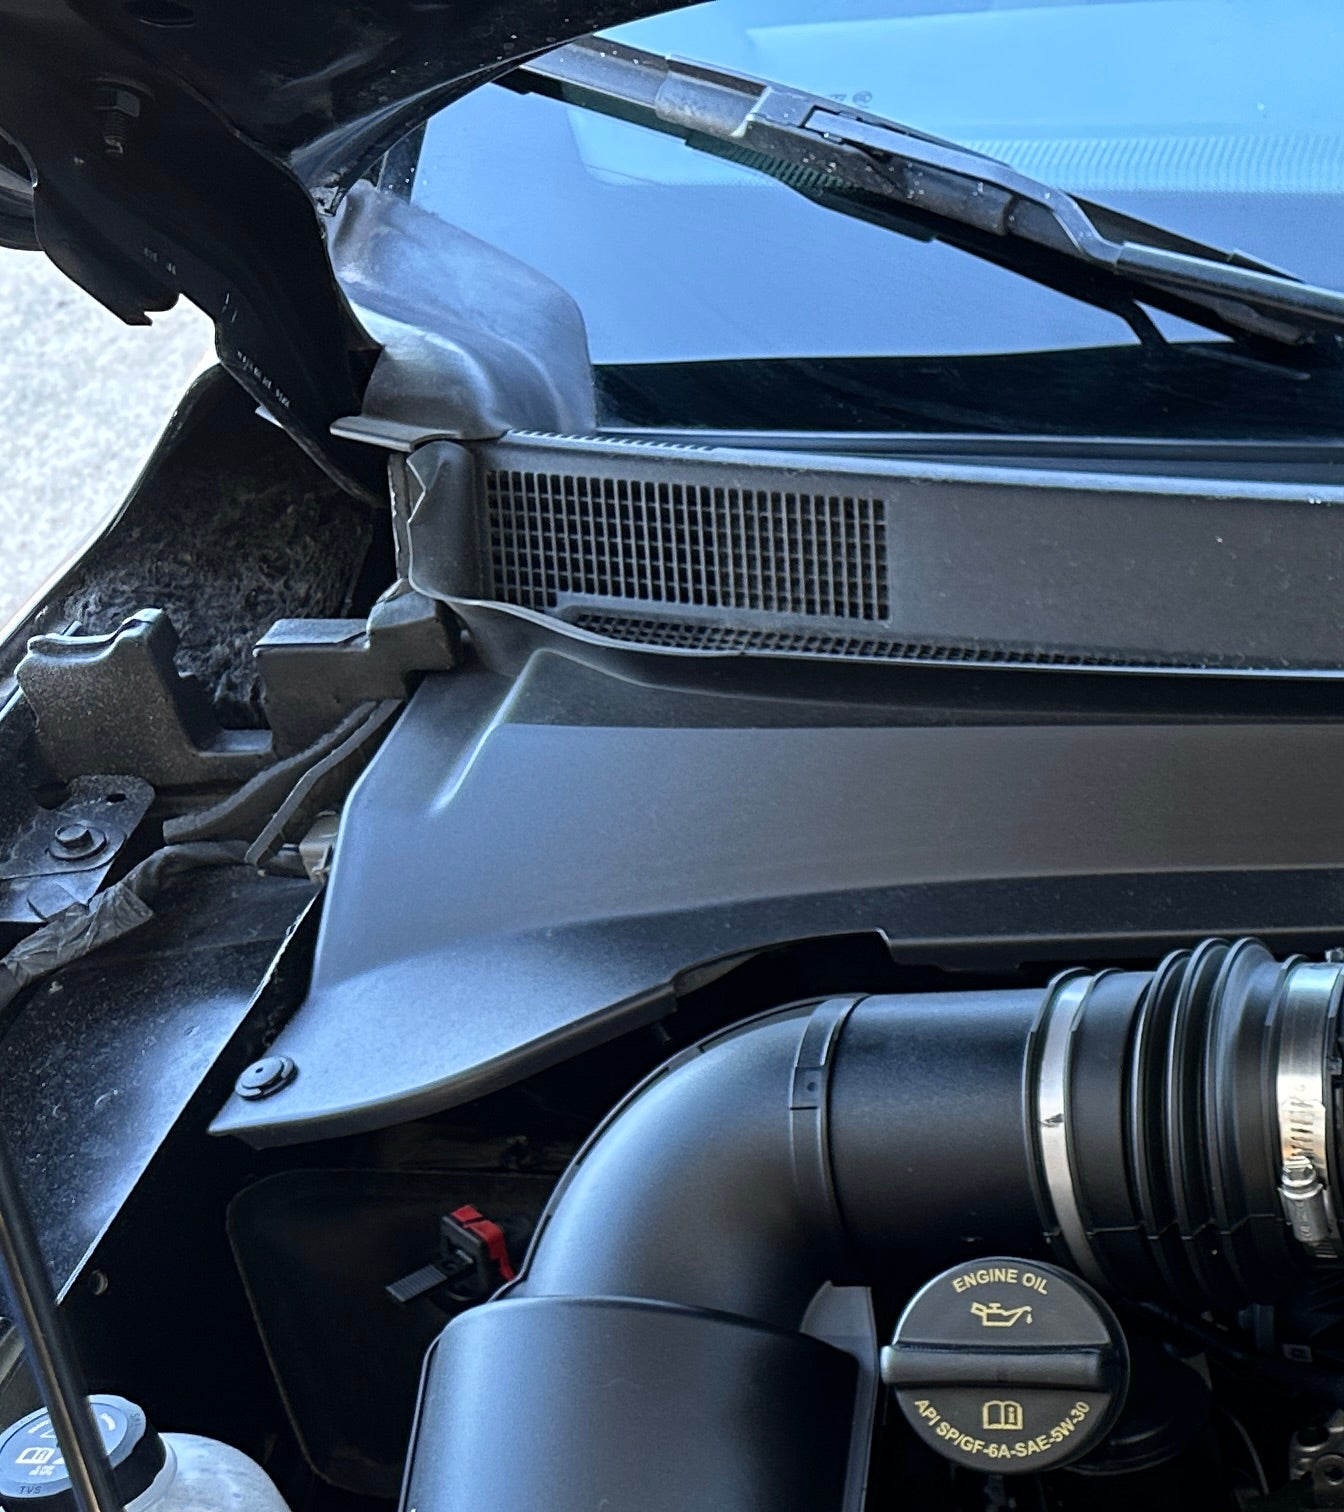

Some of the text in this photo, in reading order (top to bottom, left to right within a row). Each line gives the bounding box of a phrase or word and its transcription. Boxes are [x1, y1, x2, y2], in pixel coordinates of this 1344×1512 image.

[953, 1268, 1049, 1295] ENGINE OIL
[914, 1400, 1090, 1458] API SP/GF-6A-SAE-5W-30
[19, 1486, 42, 1494] TVS
